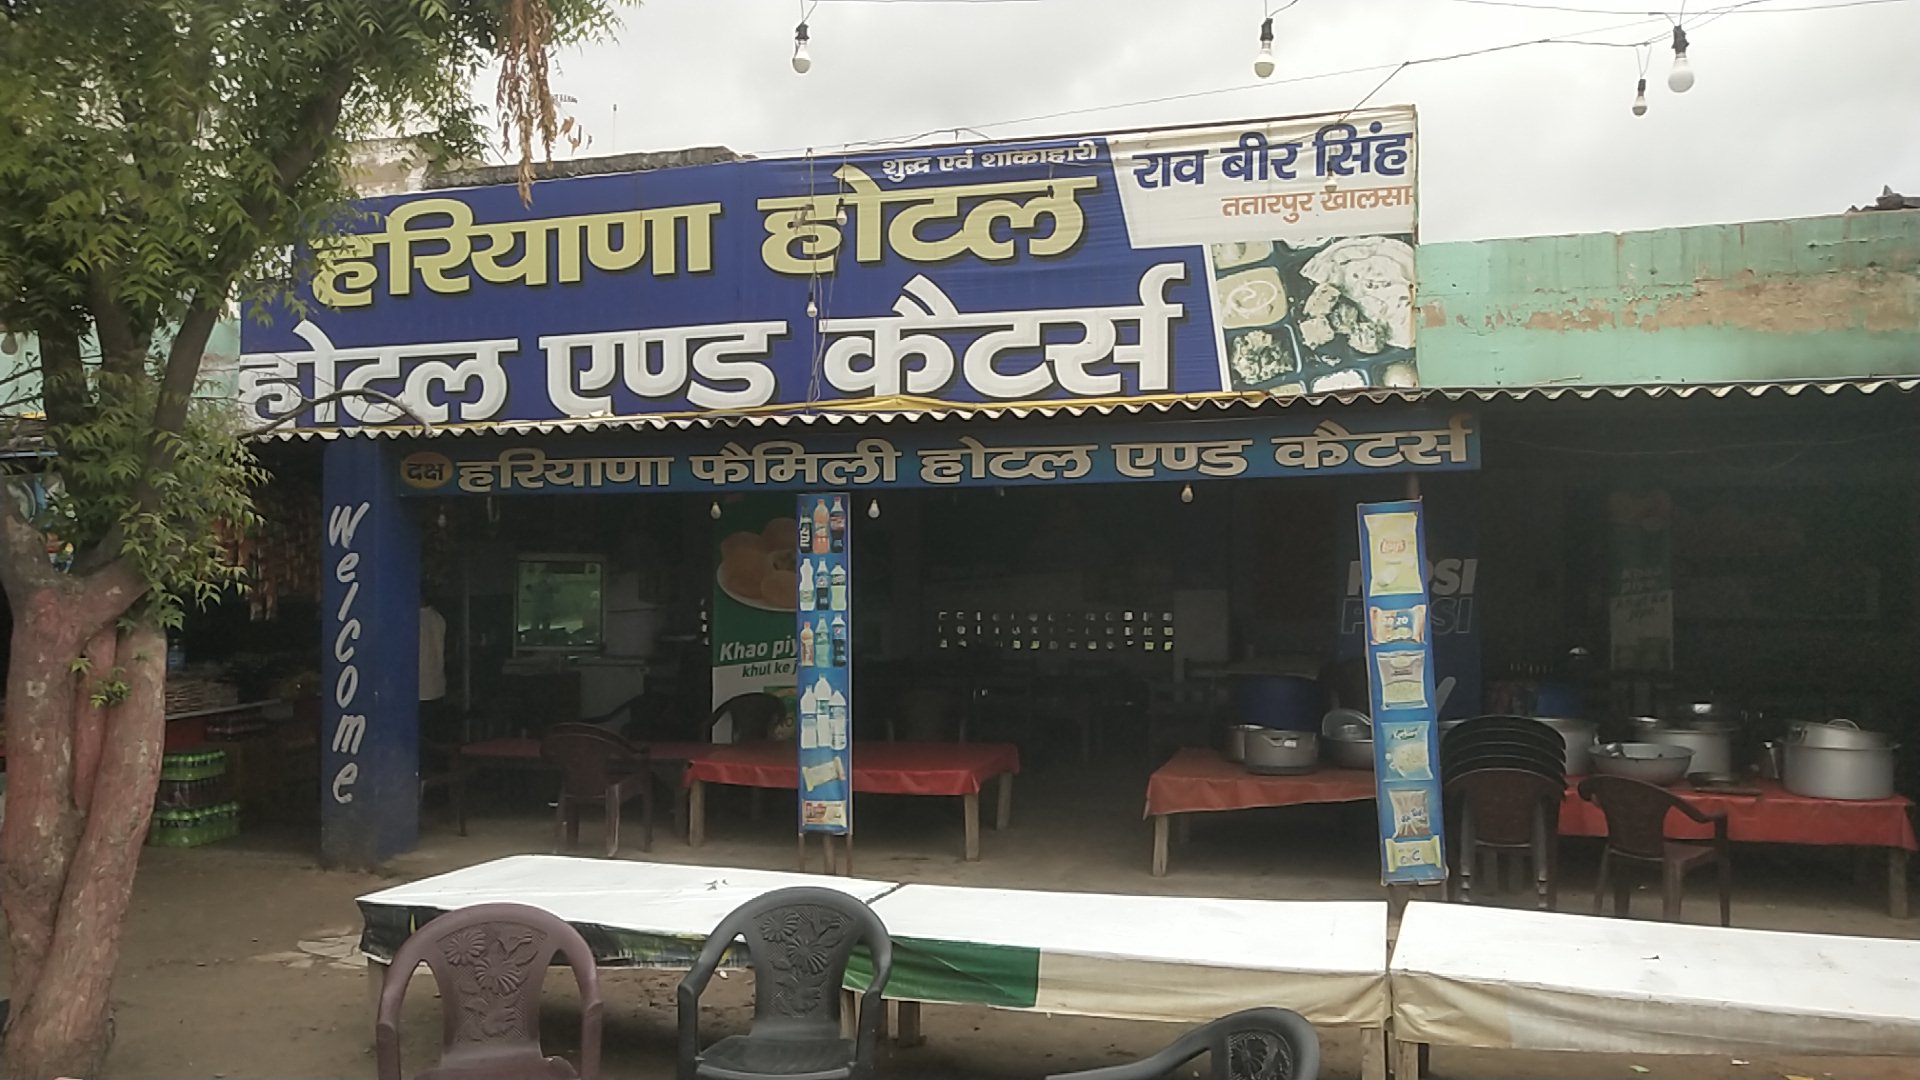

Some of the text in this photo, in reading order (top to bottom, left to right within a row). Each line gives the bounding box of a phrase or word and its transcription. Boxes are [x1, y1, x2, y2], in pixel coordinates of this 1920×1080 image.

[882, 140, 1099, 183] शुद्ध एवं शाकाहारी
[1133, 121, 1413, 190] राव बीर सिंह
[1221, 185, 1414, 224] ततारपुर खालसा
[312, 163, 1098, 308] हरियाणा होटल
[239, 262, 1186, 426] होटल एण्ड कैटर्स
[406, 462, 444, 481] दक्ष
[456, 417, 1473, 493] हरियाणा फैमिली होटल एण्ड कैटर्स
[1340, 597, 1474, 637] PSI
[719, 641, 768, 662] Khao
[742, 662, 771, 678] khul
[774, 662, 790, 675] ke
